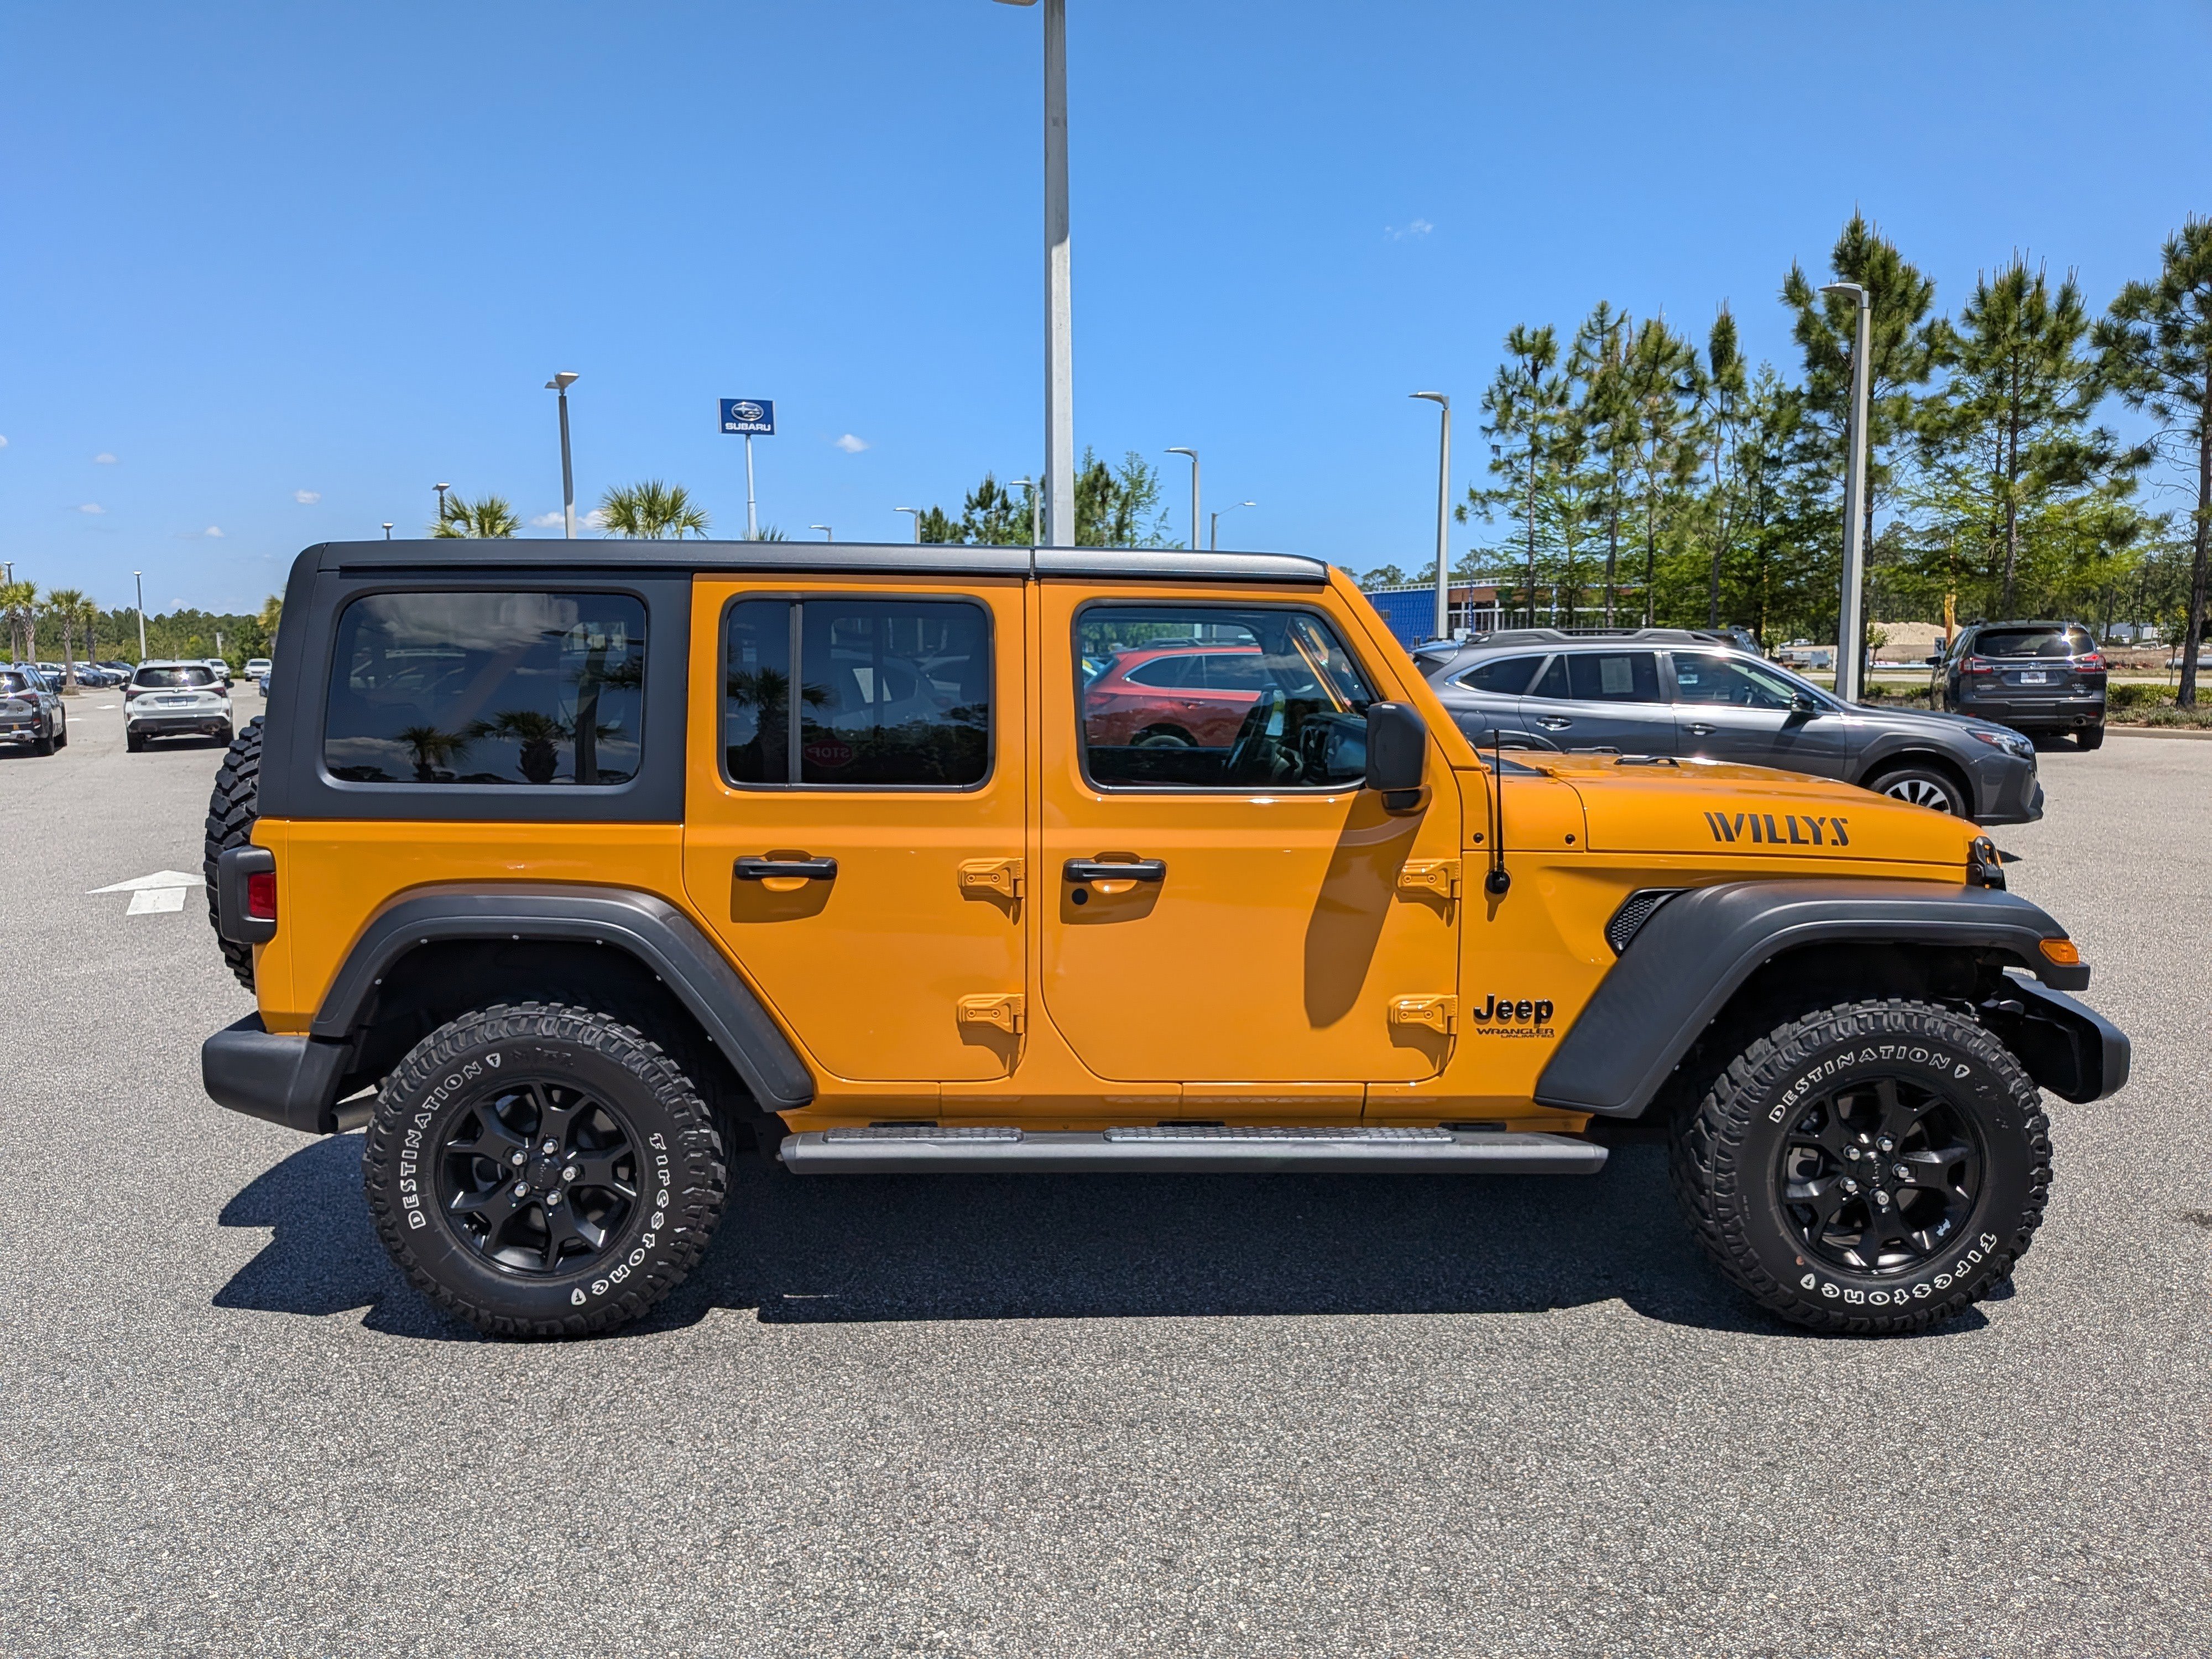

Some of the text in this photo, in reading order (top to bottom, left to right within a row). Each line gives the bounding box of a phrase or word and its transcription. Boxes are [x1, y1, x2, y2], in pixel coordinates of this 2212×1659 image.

[725, 422, 771, 431] SUBARU
[1703, 811, 1849, 846] WILLYS
[1473, 993, 1554, 1024] Jeep
[1768, 1045, 1951, 1124] DESTINATION
[400, 1061, 483, 1230] DESTINATION
